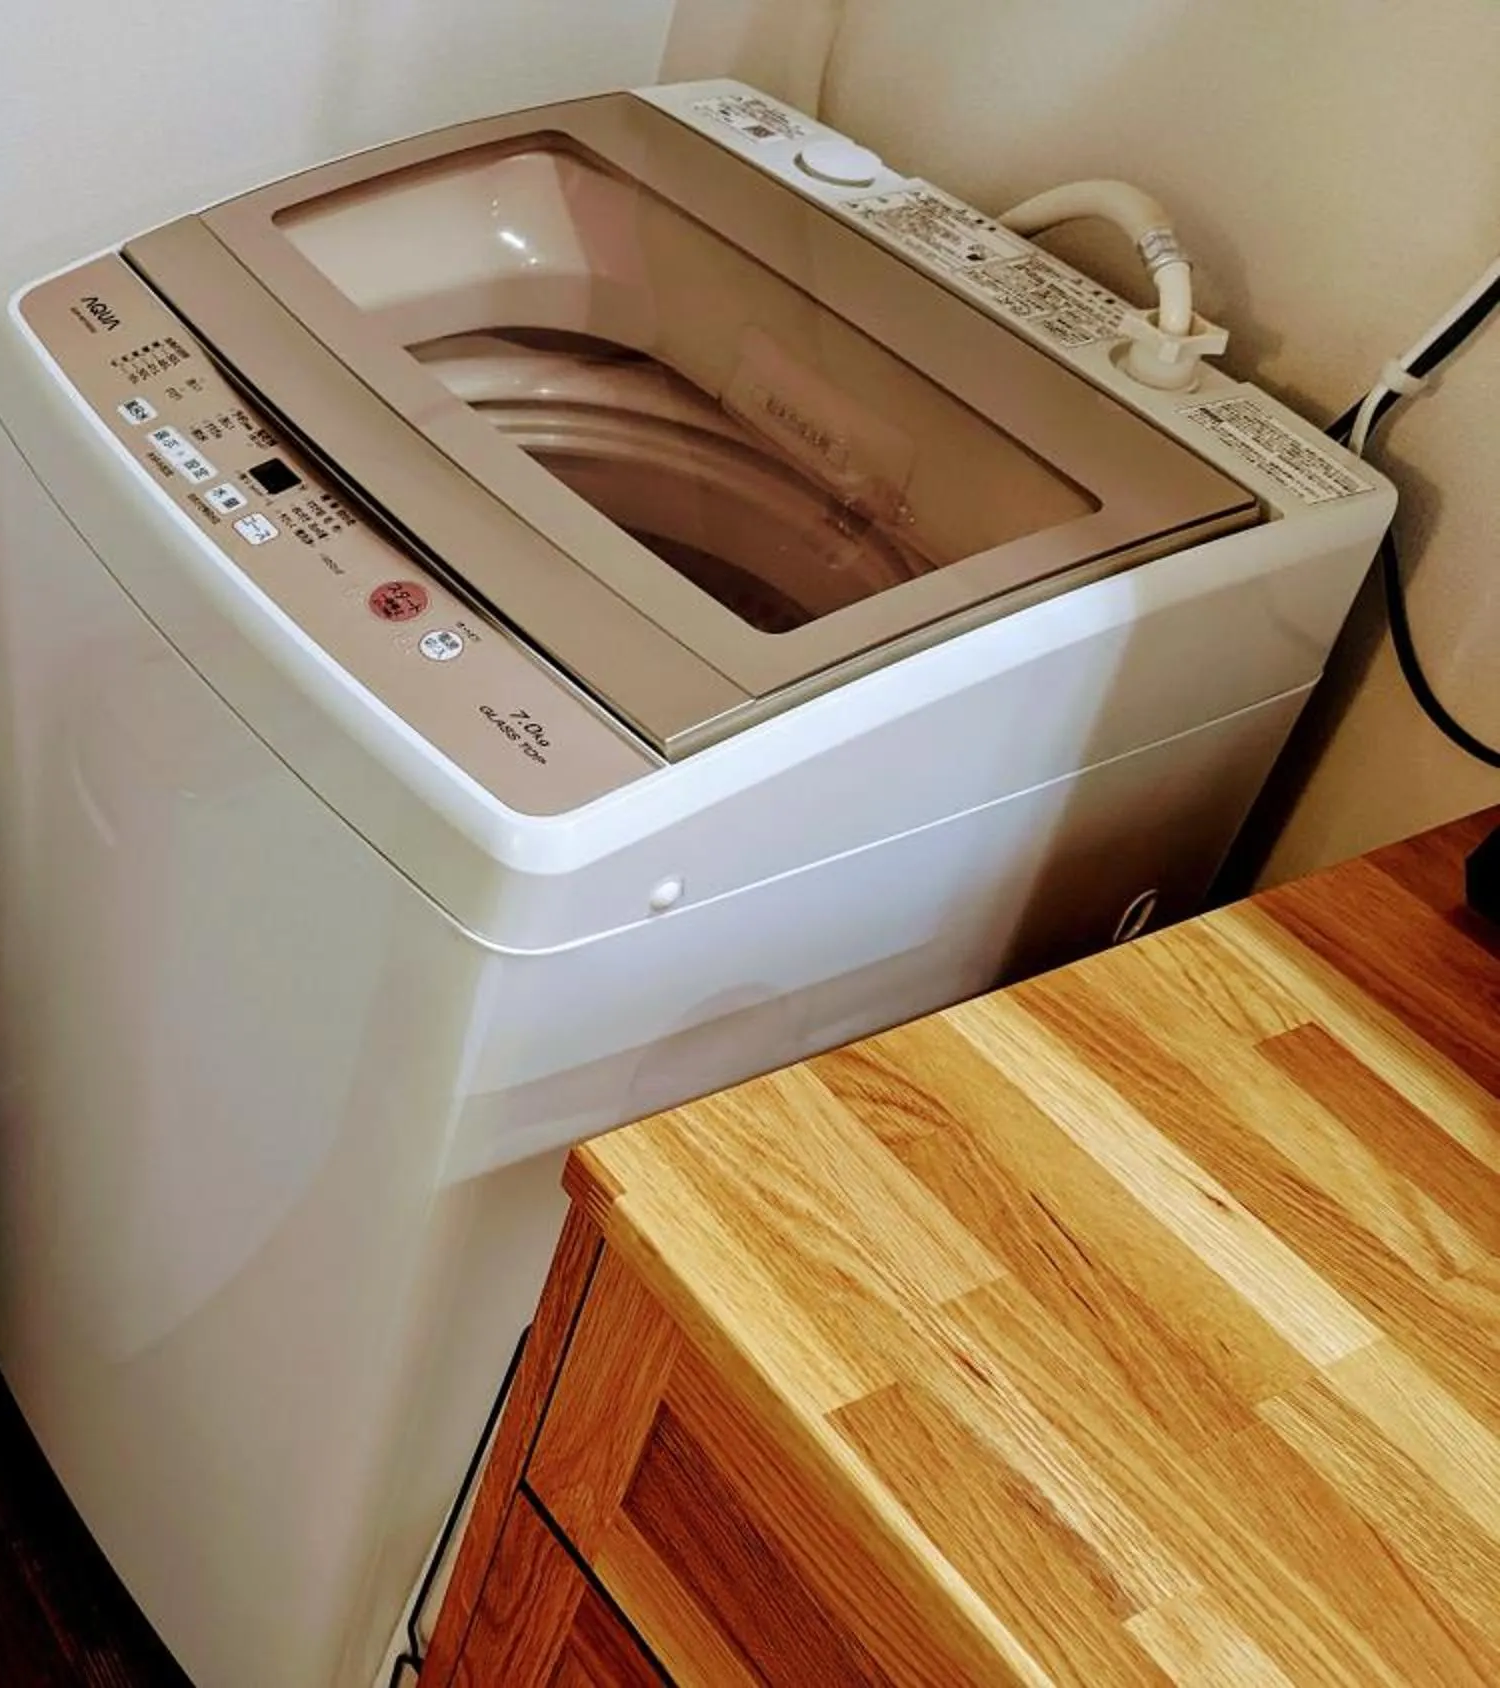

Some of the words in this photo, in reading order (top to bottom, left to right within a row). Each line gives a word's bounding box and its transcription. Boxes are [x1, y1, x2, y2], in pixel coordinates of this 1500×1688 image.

[80, 297, 120, 332] AQUA
[478, 704, 521, 742] GLASS
[519, 741, 548, 766] TOP
